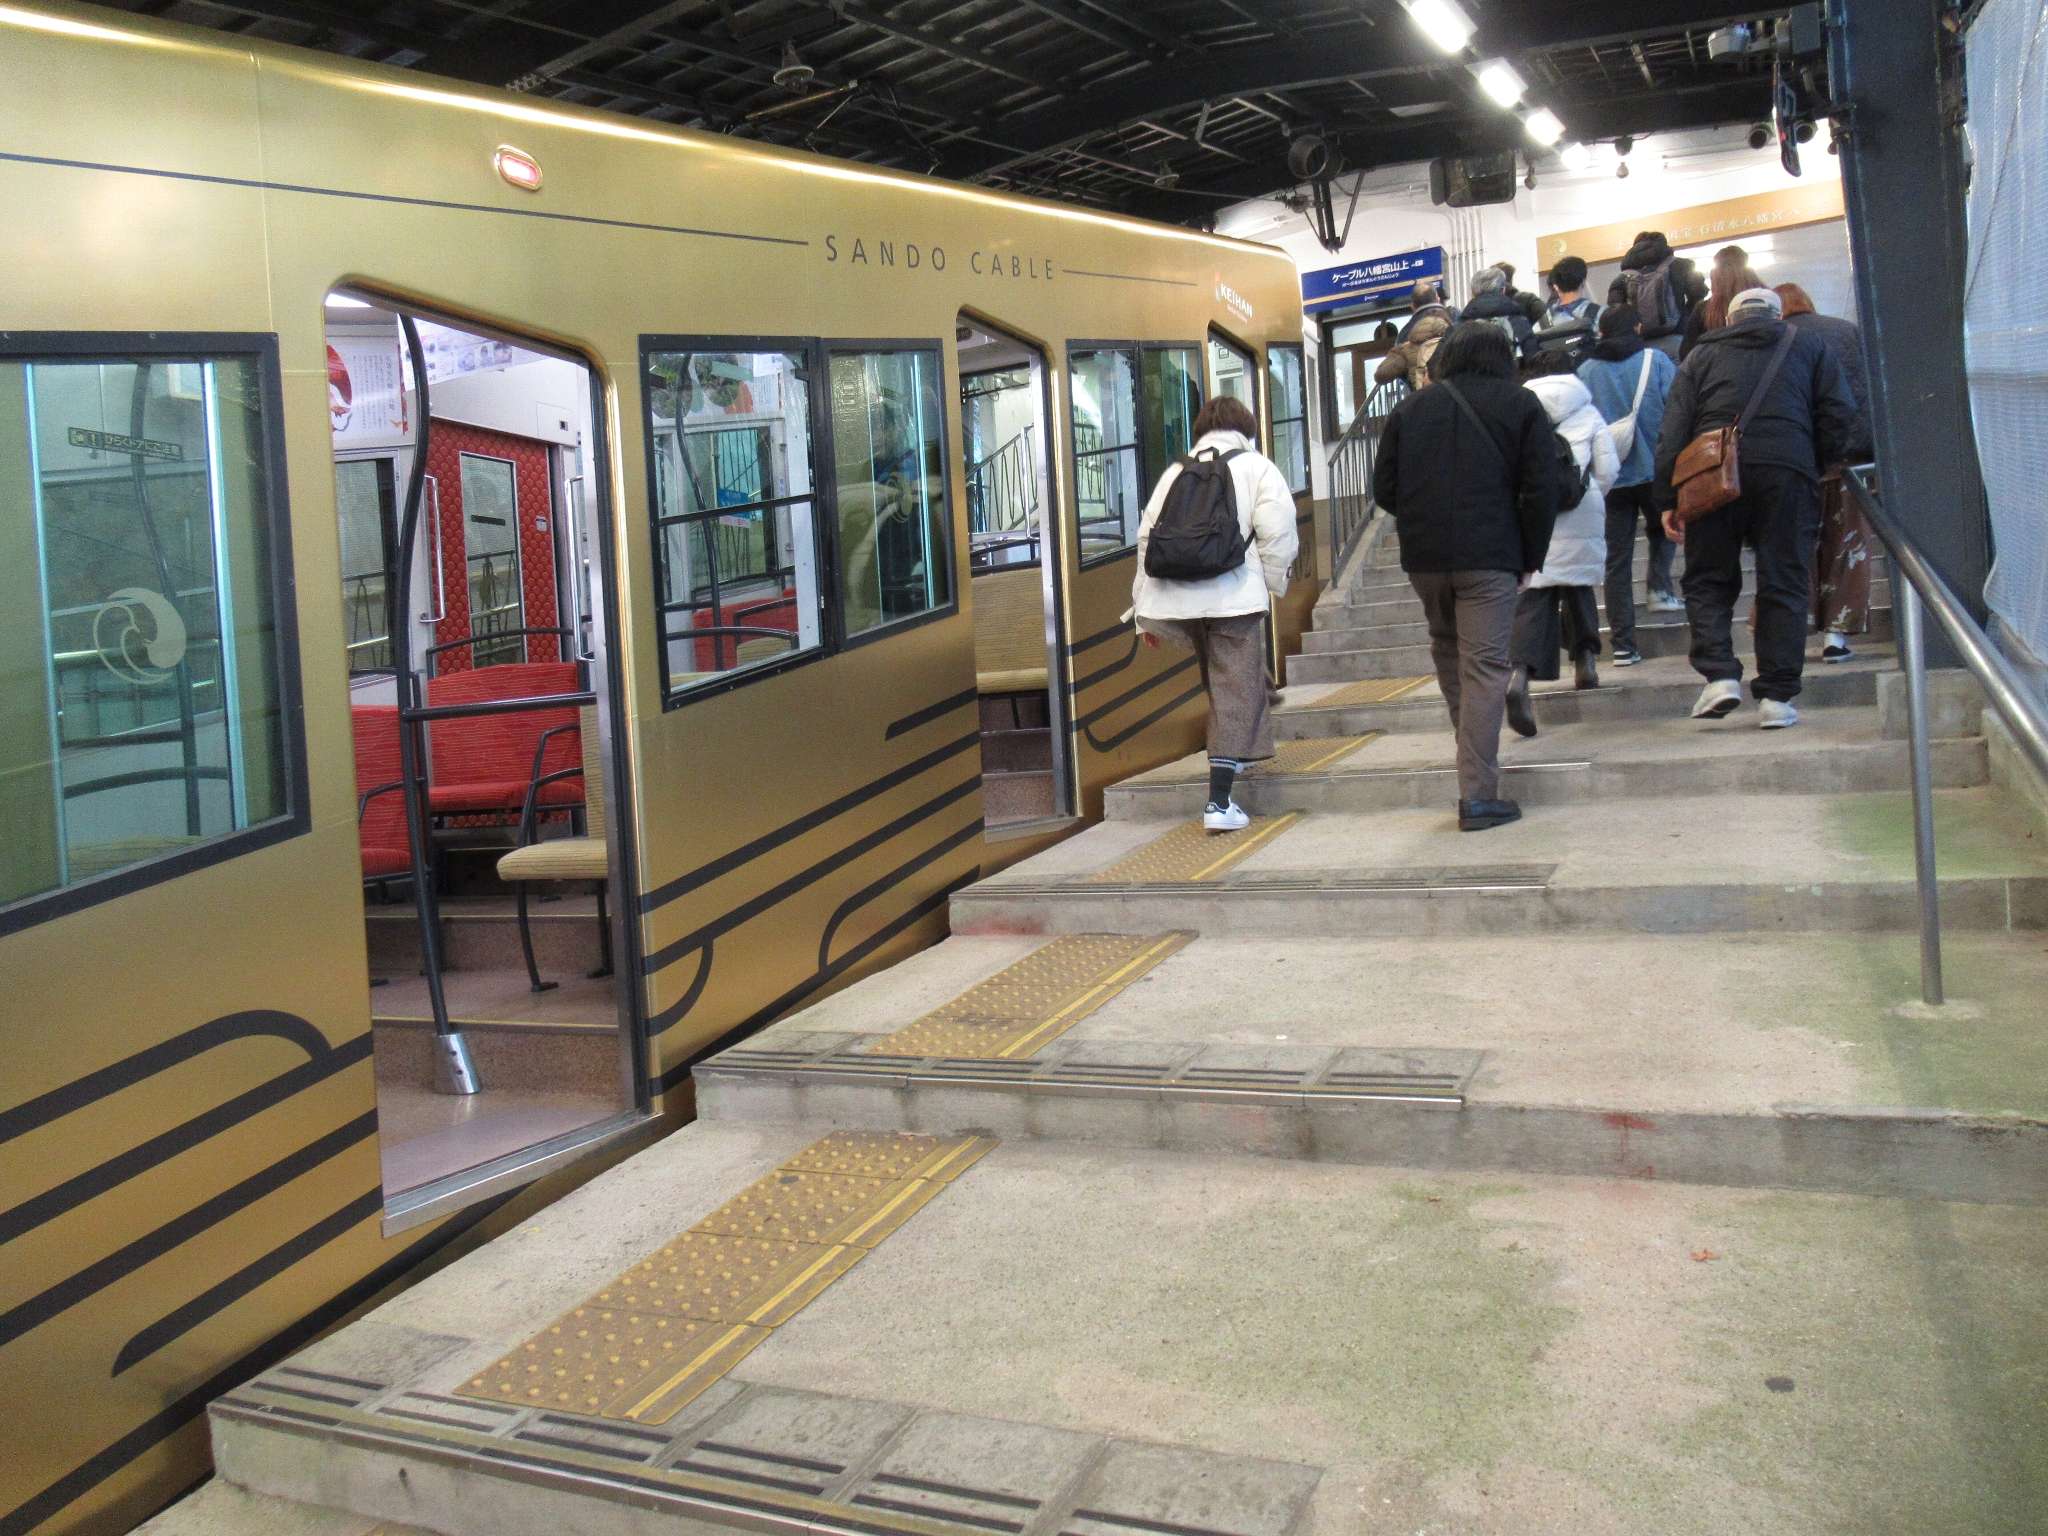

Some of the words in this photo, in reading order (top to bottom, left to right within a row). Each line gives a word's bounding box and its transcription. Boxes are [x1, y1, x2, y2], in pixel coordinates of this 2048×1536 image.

[825, 234, 946, 272] SANDO
[970, 251, 1054, 280] CABLE
[1332, 259, 1410, 284] ケーブル八幡宮山上
[1220, 281, 1253, 319] KEIHAN
